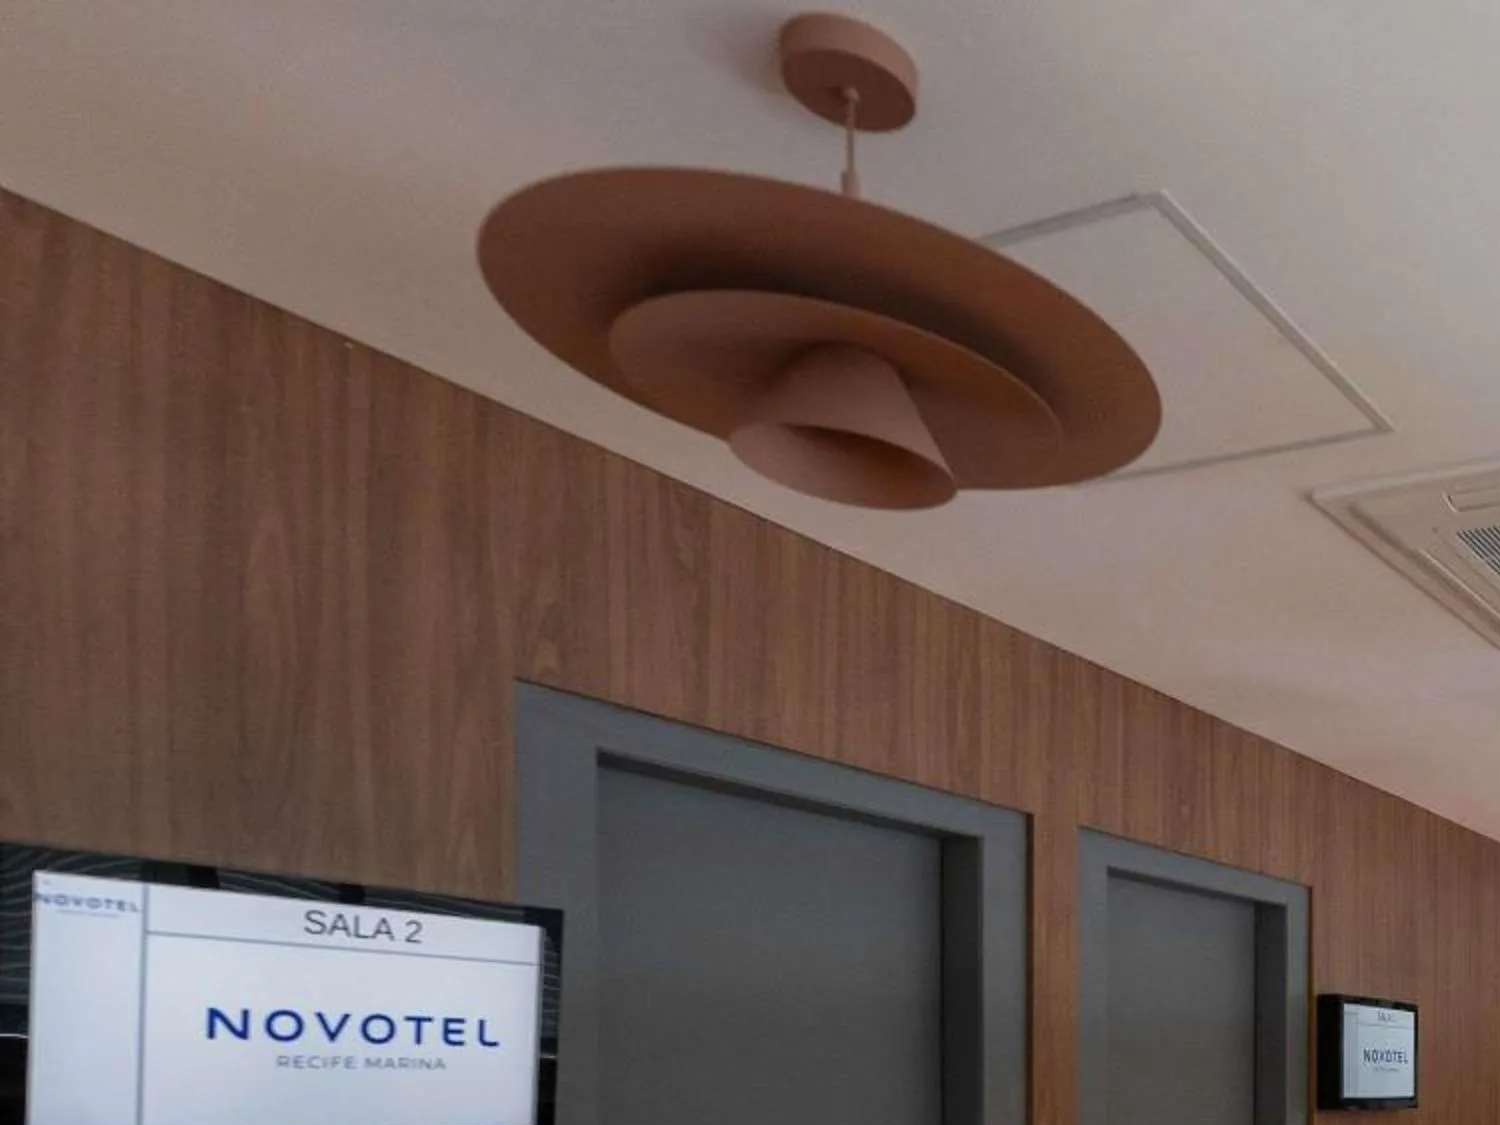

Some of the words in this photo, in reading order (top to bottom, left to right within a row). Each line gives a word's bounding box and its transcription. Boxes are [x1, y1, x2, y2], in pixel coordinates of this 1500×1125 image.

[304, 909, 395, 941] SALA
[405, 919, 423, 944] 2
[206, 1007, 500, 1047] NOVOTEL
[276, 1055, 357, 1070] RECIFE
[364, 1056, 447, 1070] MARINA
[1363, 1049, 1408, 1064] NOVOTEL
